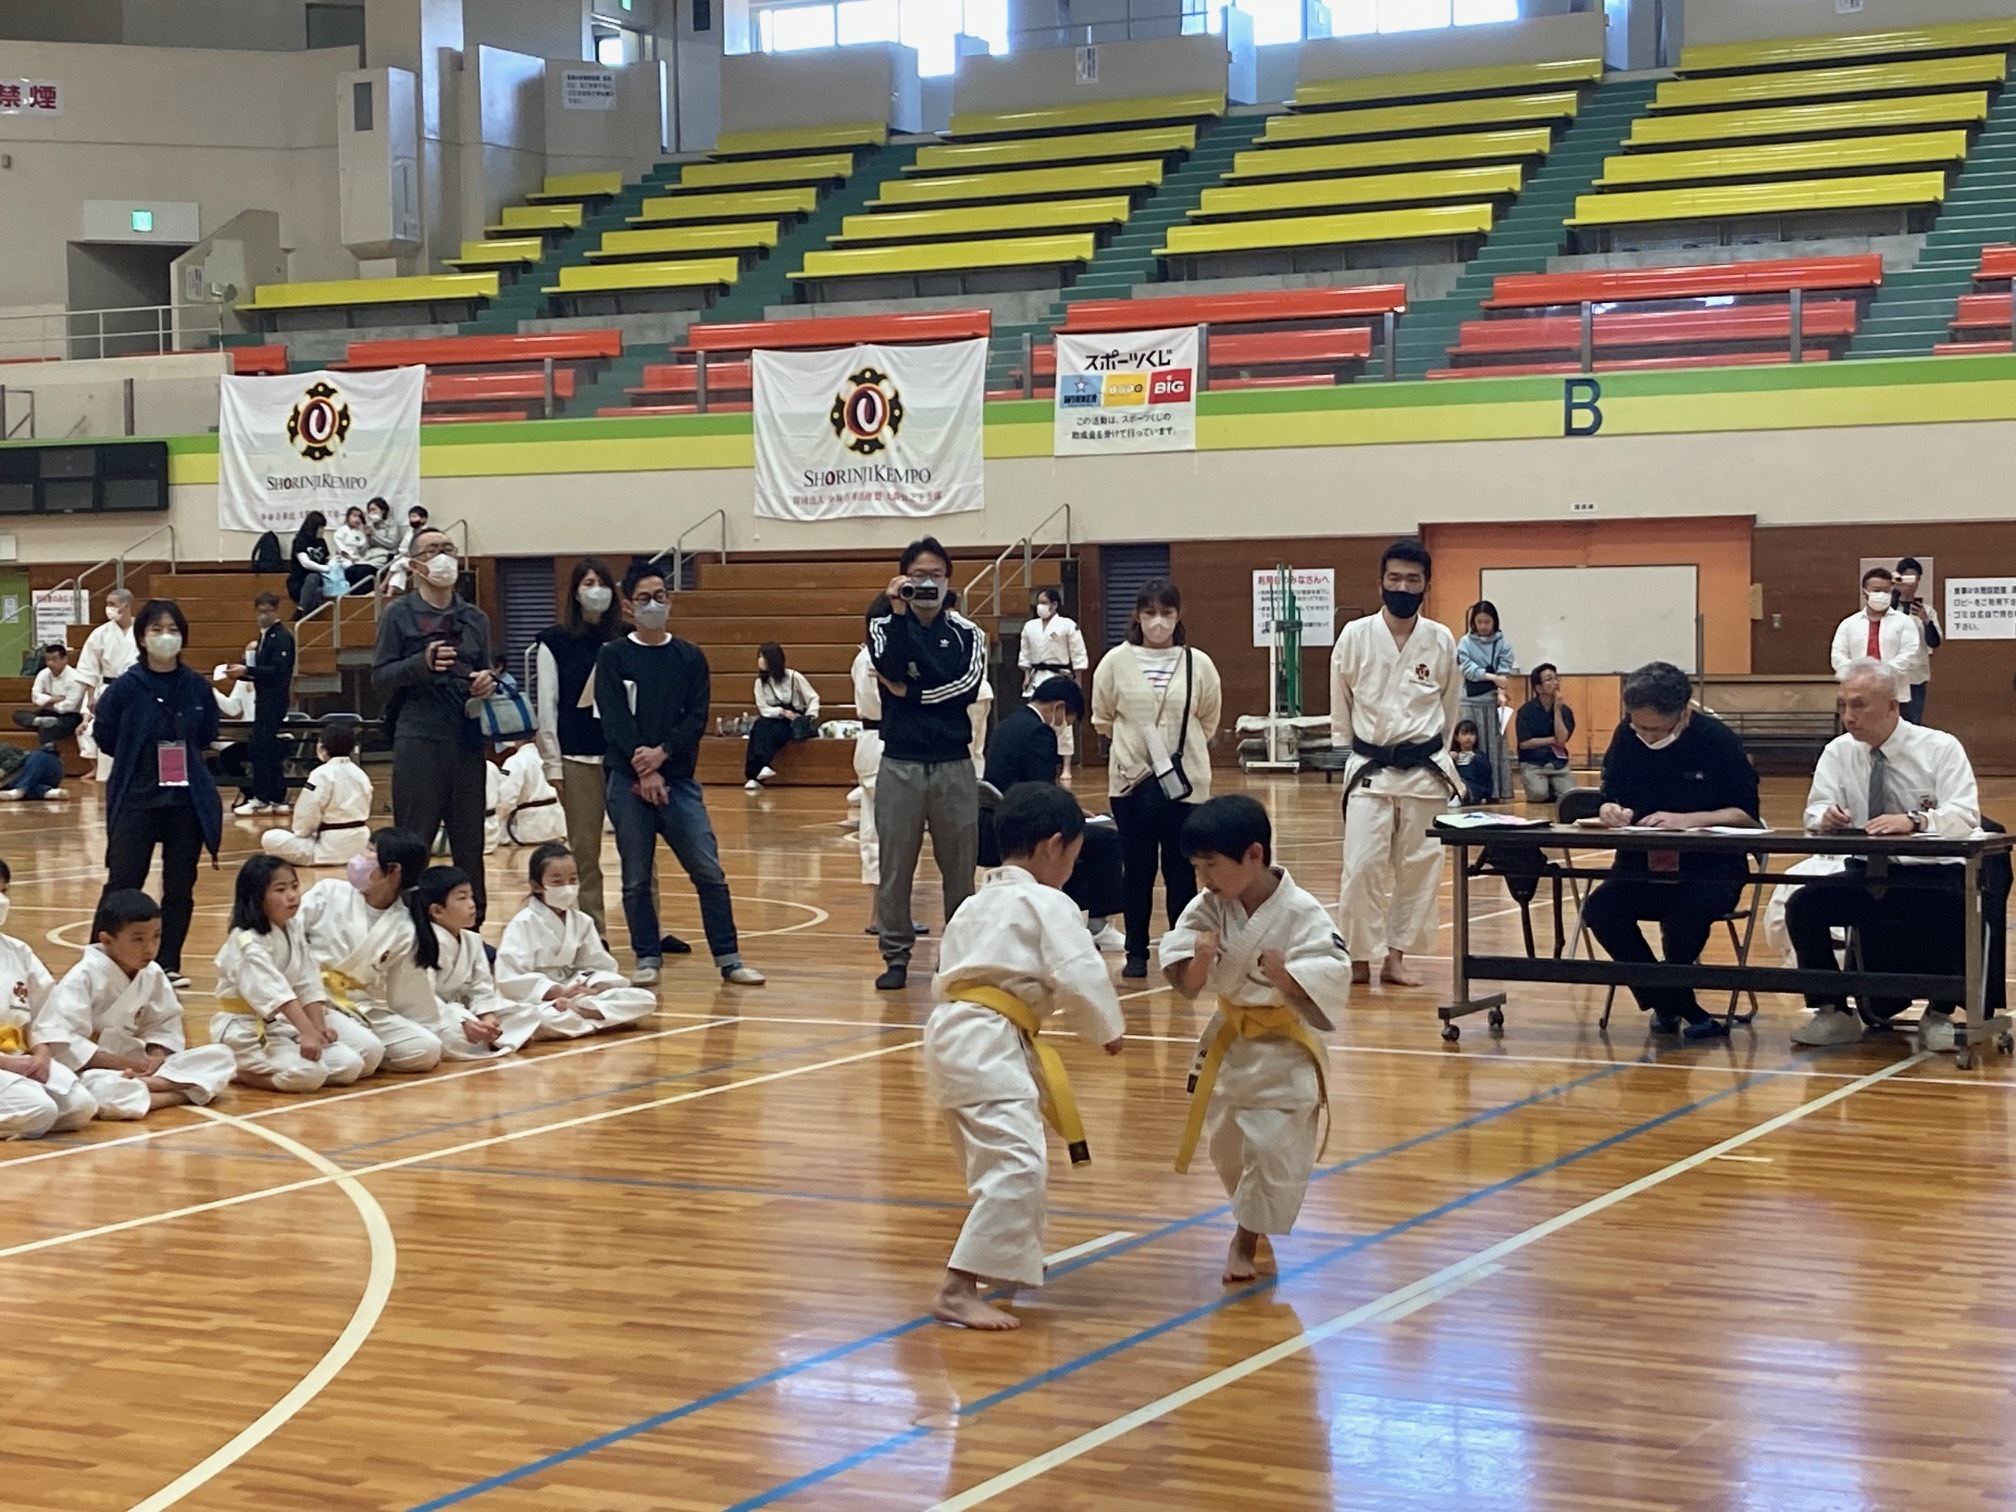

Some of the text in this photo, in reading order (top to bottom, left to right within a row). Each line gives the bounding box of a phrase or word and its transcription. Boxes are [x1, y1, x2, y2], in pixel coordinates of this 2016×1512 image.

[0, 84, 56, 109] 禁煙
[1084, 349, 1173, 371] スポーツくじ
[1565, 378, 1603, 436] B
